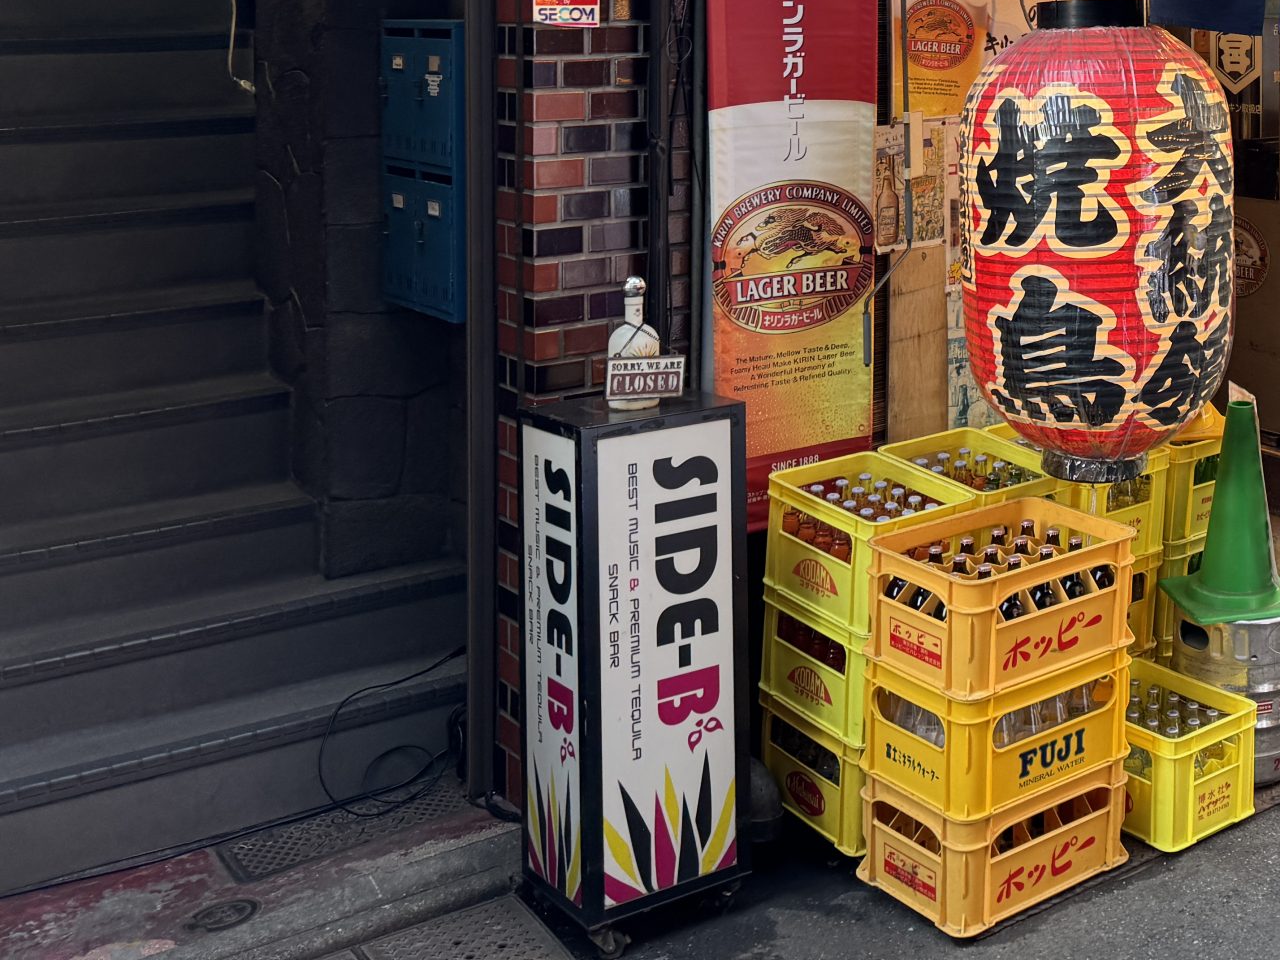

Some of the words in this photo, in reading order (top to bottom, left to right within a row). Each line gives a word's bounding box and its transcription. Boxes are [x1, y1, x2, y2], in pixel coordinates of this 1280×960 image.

[538, 7, 595, 22] SECOM
[912, 41, 938, 52] LAGER
[941, 43, 960, 54] BEER
[713, 216, 734, 248] KIRIN
[734, 188, 782, 219] BREWERY
[786, 186, 840, 208] COMPANY,
[841, 198, 873, 235] LIMITED
[977, 92, 1128, 426] 焼鳥
[736, 276, 796, 302] LAGER
[802, 270, 849, 294] BEER
[763, 309, 822, 328] キリンラガービール
[611, 361, 644, 373] SORRY,
[647, 360, 662, 371] WE
[664, 359, 682, 370] ARE
[793, 355, 816, 365] KIRIN
[817, 352, 838, 362] Lager
[840, 349, 856, 358] Beer
[803, 345, 824, 354] Taste
[612, 371, 680, 393] CLOSED
[771, 458, 797, 473] SINCE
[627, 463, 638, 510] BEST
[628, 517, 640, 573] MUSIC
[629, 578, 639, 591] &
[653, 455, 720, 726] SIDE-B
[800, 559, 832, 592] KODAMA
[544, 458, 574, 735] SIDE-B
[608, 563, 619, 625] SNACK
[609, 631, 620, 669] BAR
[629, 598, 641, 679] PREMIUM
[893, 624, 939, 648] ホッピー
[1003, 611, 1103, 672] ホッピー
[794, 666, 826, 700] KODAMA
[630, 683, 642, 761] TEQUILA
[1019, 728, 1086, 779] FUJI
[1018, 769, 1054, 789] MINERAL
[1056, 756, 1086, 775] WATER
[886, 852, 933, 880] ホッピー
[996, 835, 1096, 903] ホッピー
